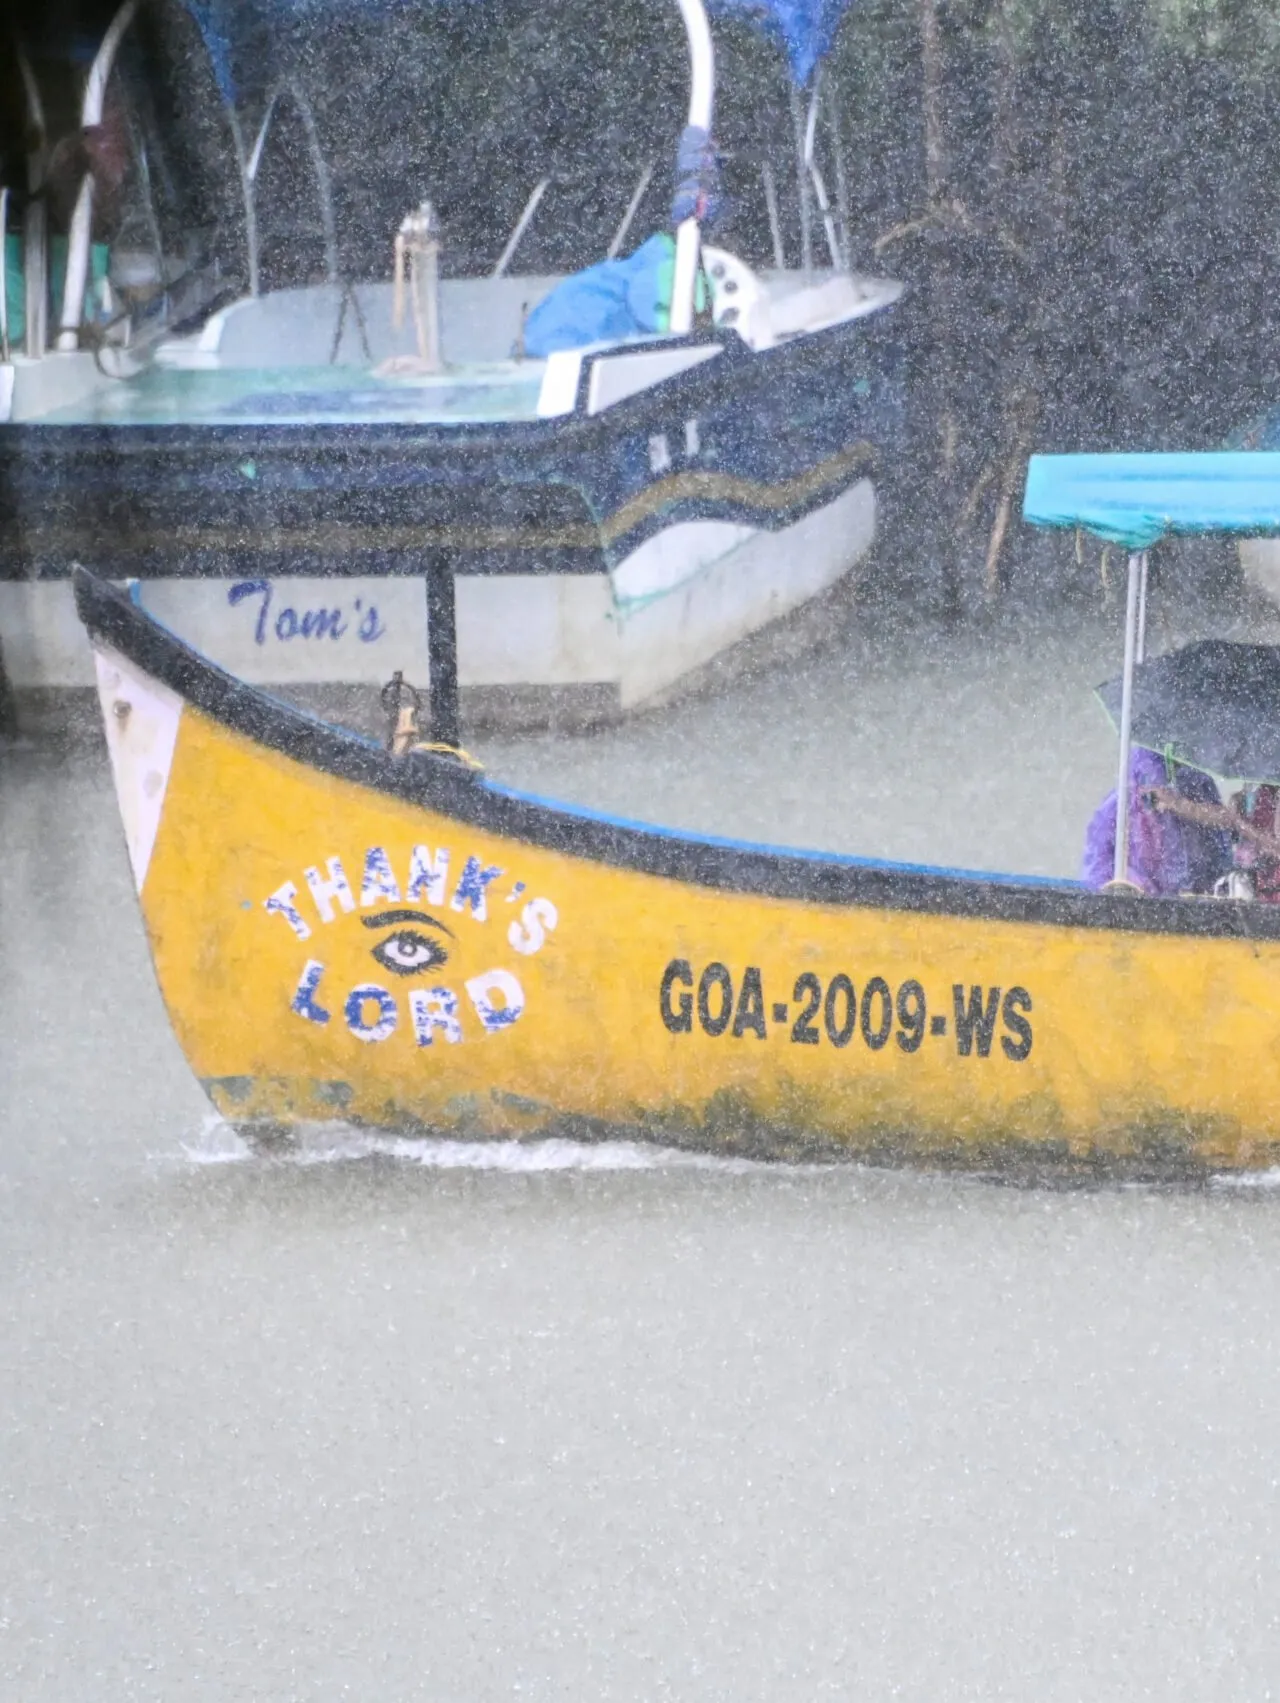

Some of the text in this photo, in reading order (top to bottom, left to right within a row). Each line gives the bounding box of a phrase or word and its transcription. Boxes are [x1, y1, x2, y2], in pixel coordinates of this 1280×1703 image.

[227, 579, 387, 646] Tom's
[262, 844, 559, 956] THANK'S
[291, 958, 526, 1048] LORD
[659, 958, 1033, 1062] GOA-2009-WS
